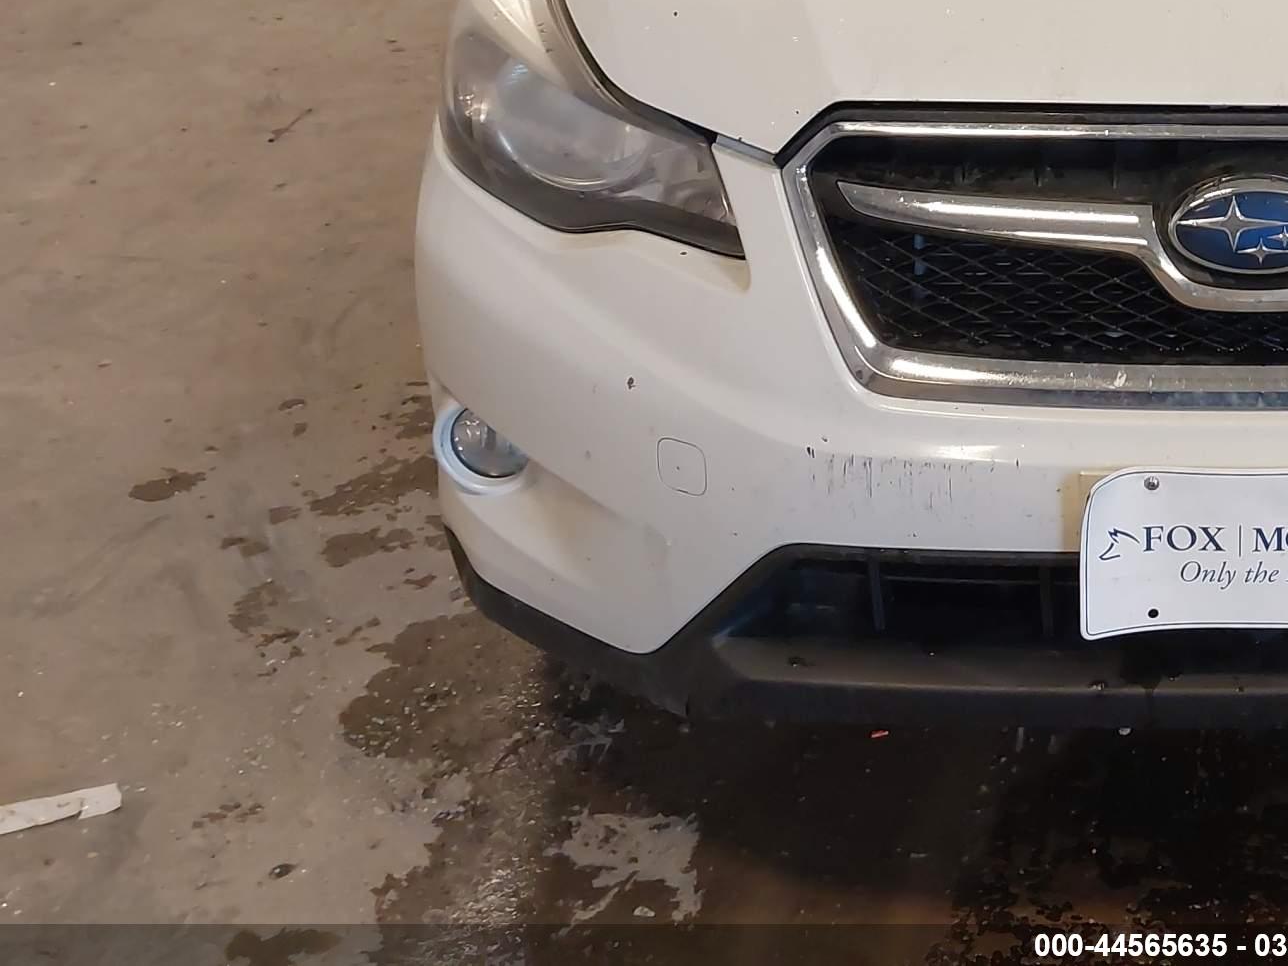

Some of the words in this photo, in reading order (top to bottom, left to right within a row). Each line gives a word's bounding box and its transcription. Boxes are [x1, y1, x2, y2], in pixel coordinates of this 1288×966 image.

[1143, 525, 1225, 552] FOX
[1180, 560, 1237, 590] Only
[1244, 561, 1280, 584] the
